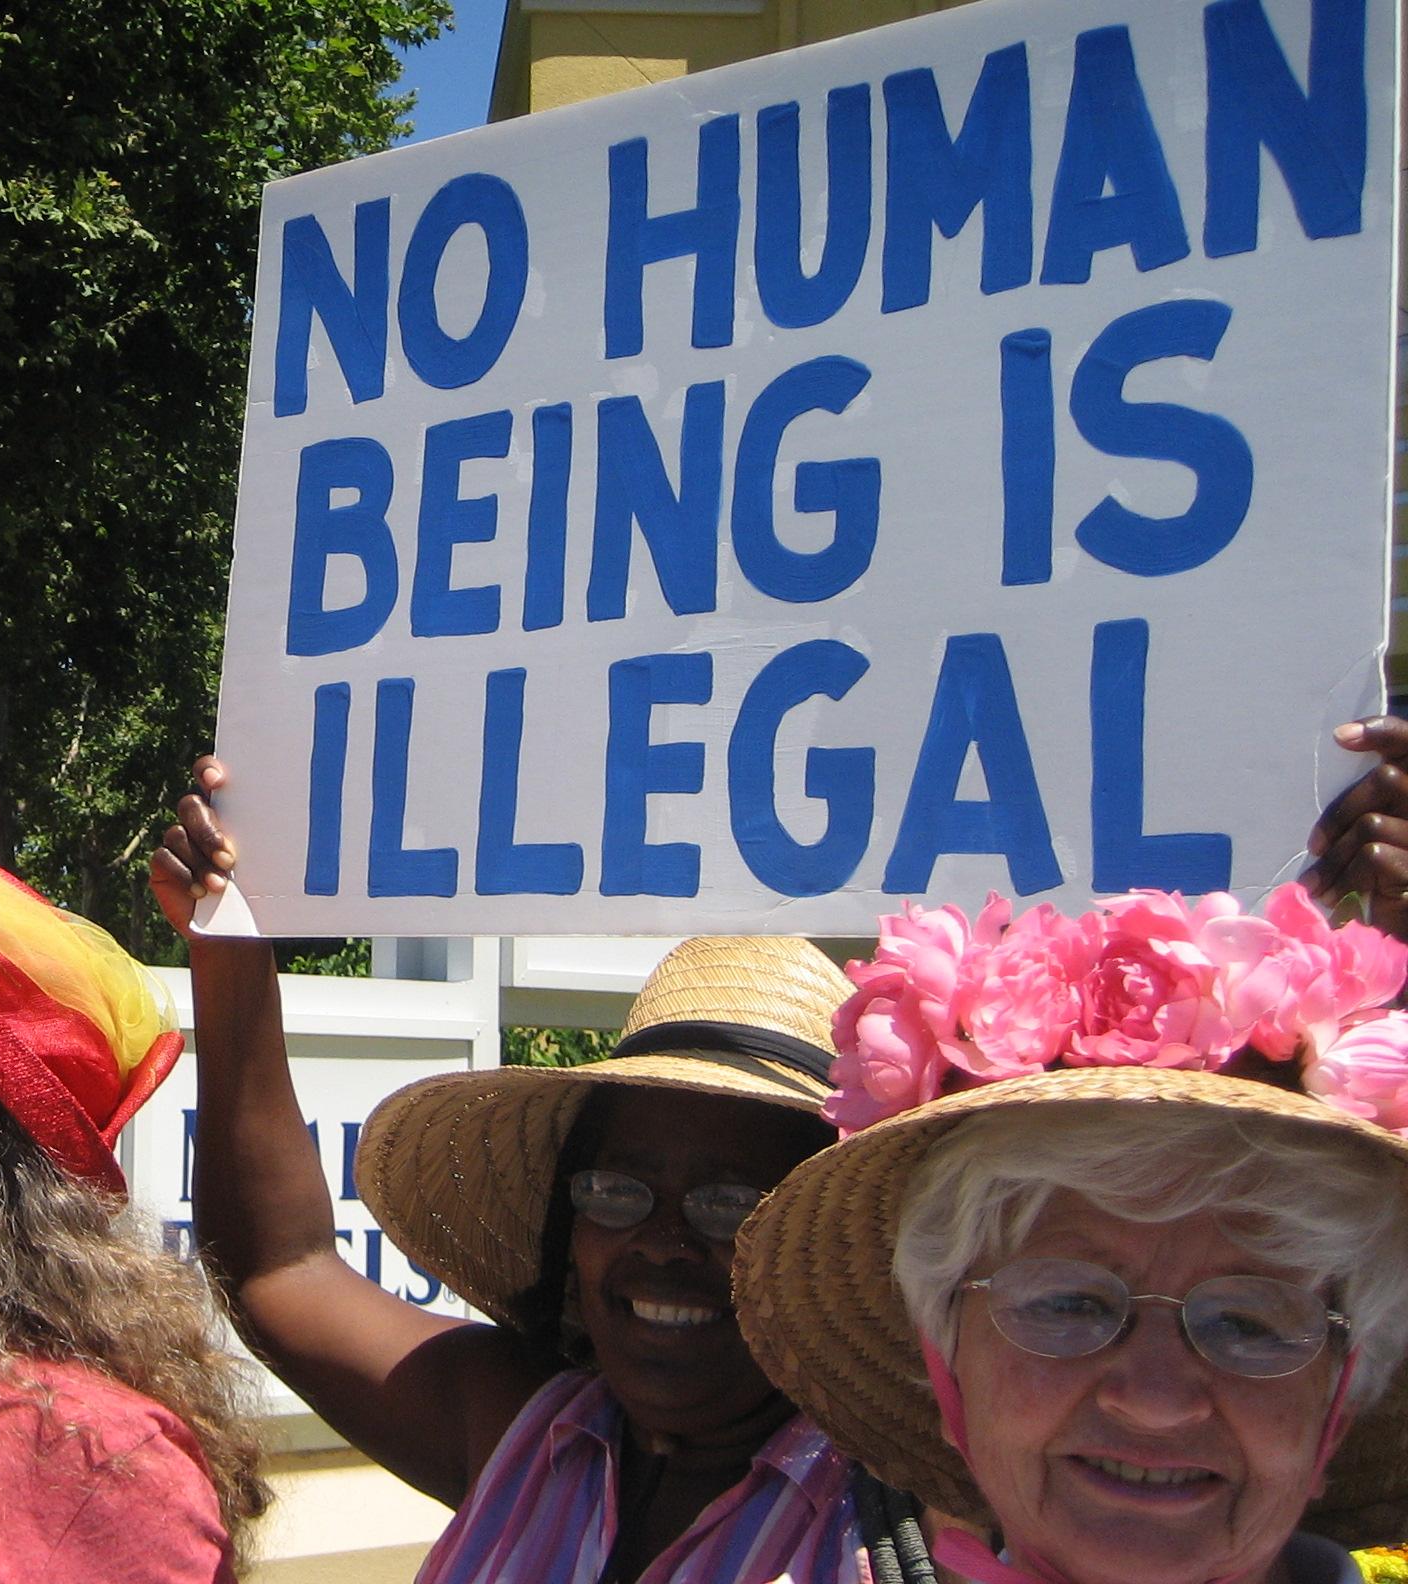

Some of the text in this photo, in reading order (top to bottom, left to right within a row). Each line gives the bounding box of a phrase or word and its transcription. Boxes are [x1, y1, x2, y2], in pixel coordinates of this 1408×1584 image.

[274, 0, 1369, 418] NO HUMAN
[286, 299, 1255, 657] BEING IS
[304, 618, 1233, 899] ILLEGAL
